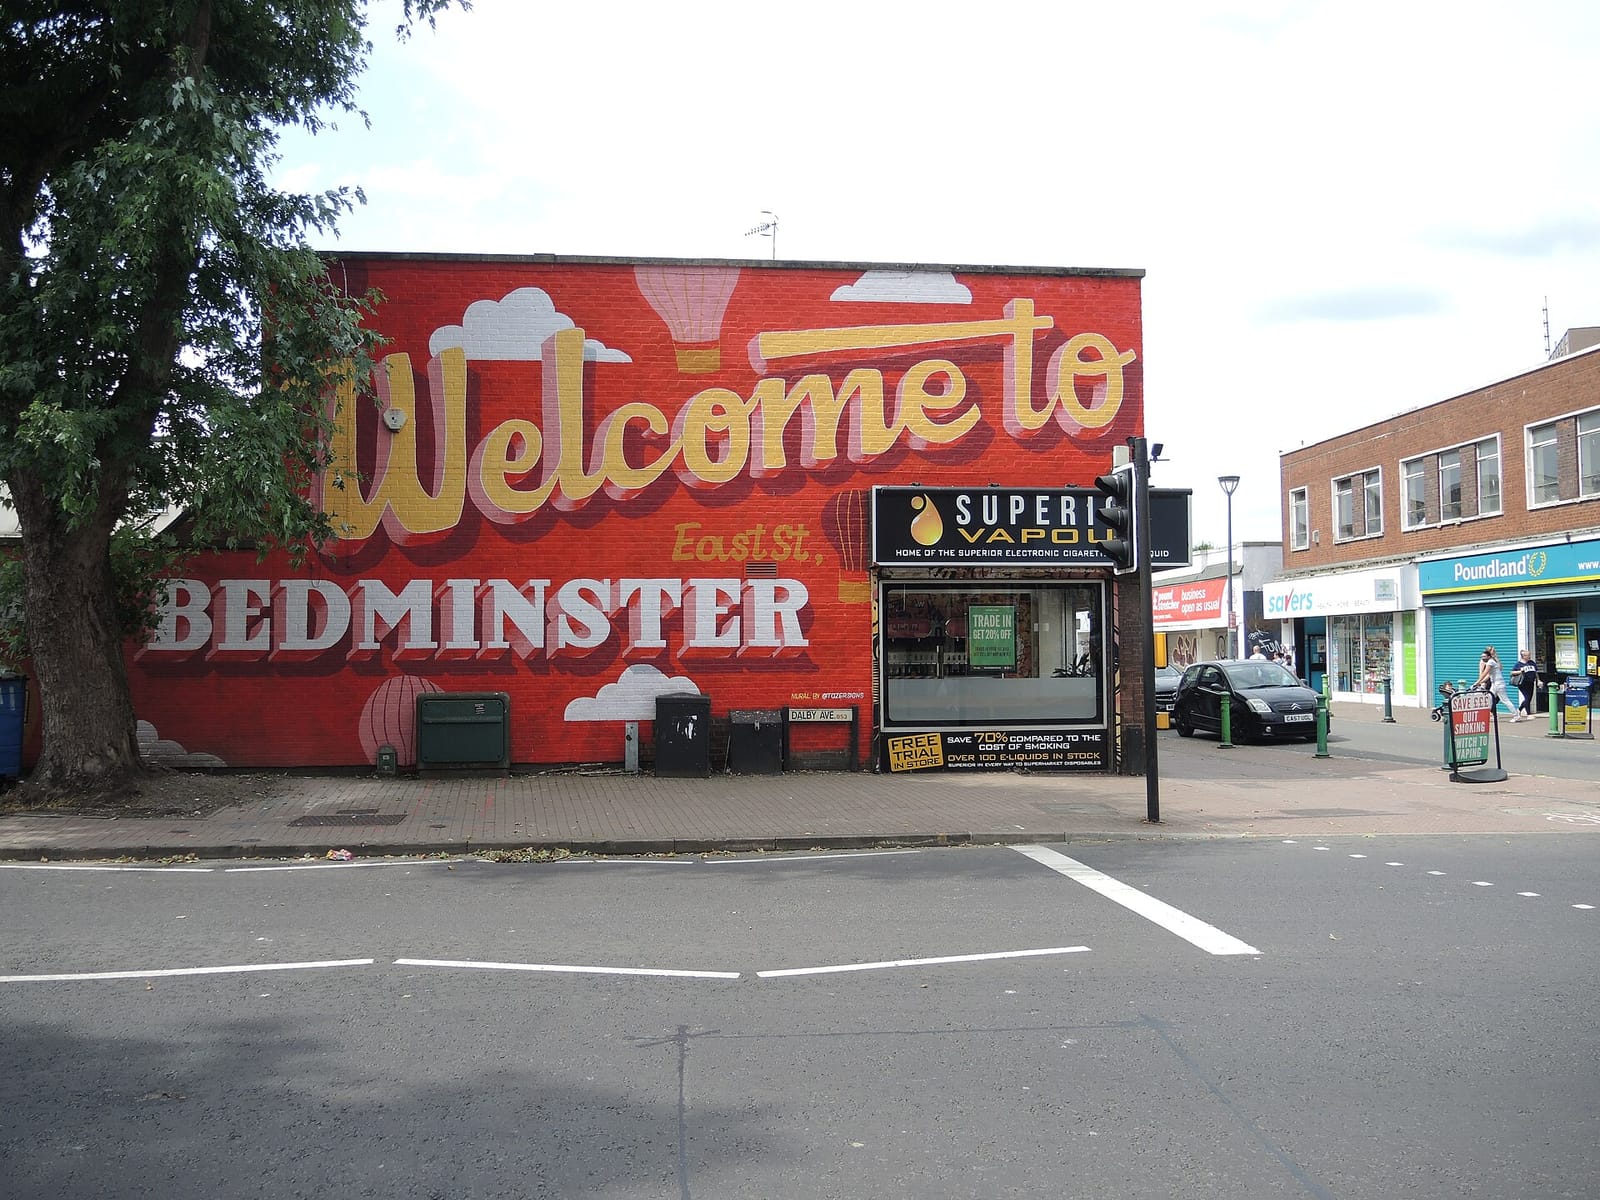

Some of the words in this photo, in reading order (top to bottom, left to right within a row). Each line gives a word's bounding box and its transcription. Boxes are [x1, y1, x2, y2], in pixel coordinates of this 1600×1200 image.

[319, 328, 981, 540] Welcome
[758, 298, 1137, 430] to
[956, 495, 1114, 526] SUPERI
[672, 522, 767, 562] East
[957, 528, 1113, 545] VAPOU
[895, 549, 921, 557] HOME
[924, 549, 936, 557] OF
[938, 549, 955, 557] THE
[958, 549, 1002, 557] SUPERIOR
[1005, 549, 1059, 558] ELECTRONIC
[1454, 556, 1527, 581] Poundland
[1268, 588, 1313, 613] savers
[148, 578, 810, 650] BEDMINSTER
[972, 614, 1001, 628] TRADE
[1002, 614, 1012, 628] IN
[973, 629, 985, 640] GET
[985, 629, 1000, 640] 20%
[1000, 629, 1012, 640] OFF
[1453, 697, 1471, 711] SAVE
[1474, 696, 1489, 708] £££
[791, 710, 817, 720] DALBY
[1463, 711, 1478, 723] QUIT
[1454, 721, 1486, 735] SMOKING
[892, 735, 938, 750] FREE
[947, 736, 972, 744] SAVE
[974, 732, 1008, 743] 70%
[1010, 734, 1063, 743] COMPARED
[1066, 734, 1079, 742] TO
[1082, 734, 1101, 742] THE
[1456, 736, 1477, 749] WITCH
[1479, 735, 1488, 747] TO
[979, 743, 1006, 751] COST
[1025, 742, 1070, 750] SMOKING
[1456, 747, 1482, 760] VAPING
[893, 747, 940, 762] TRIAL
[1053, 752, 1063, 760] IN
[1067, 752, 1101, 760] STOCK
[907, 757, 940, 768] STORE
